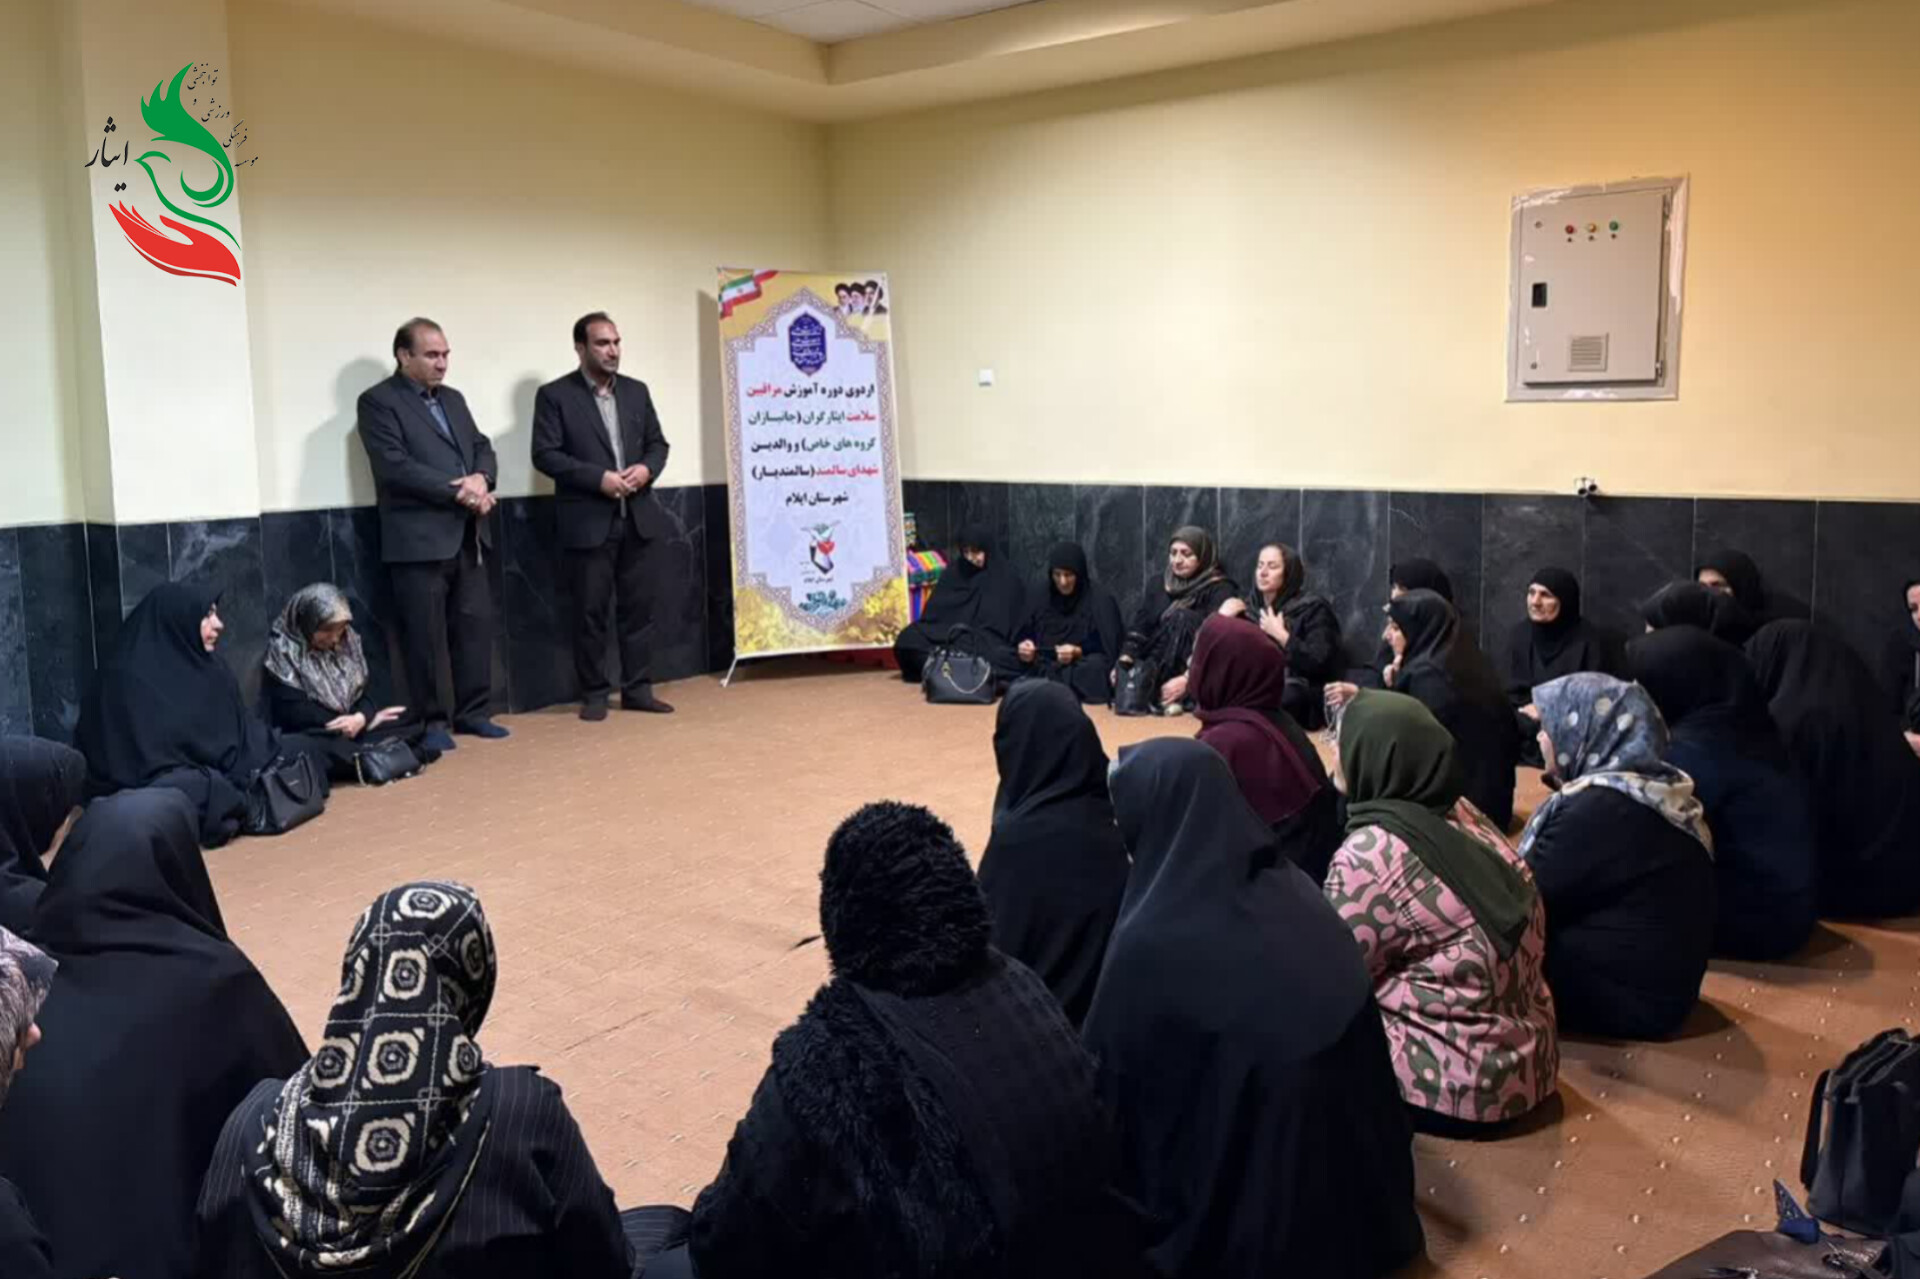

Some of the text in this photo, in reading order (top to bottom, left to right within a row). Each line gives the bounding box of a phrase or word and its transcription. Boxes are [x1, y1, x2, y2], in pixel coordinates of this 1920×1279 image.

[784, 383, 818, 397] آموزش
[821, 386, 843, 398] دوره
[845, 384, 874, 398] اردوی
[803, 411, 845, 424] ایثارگران
[846, 410, 876, 421] سلامت
[751, 438, 792, 452] والدین
[809, 491, 849, 505] شهرستان
